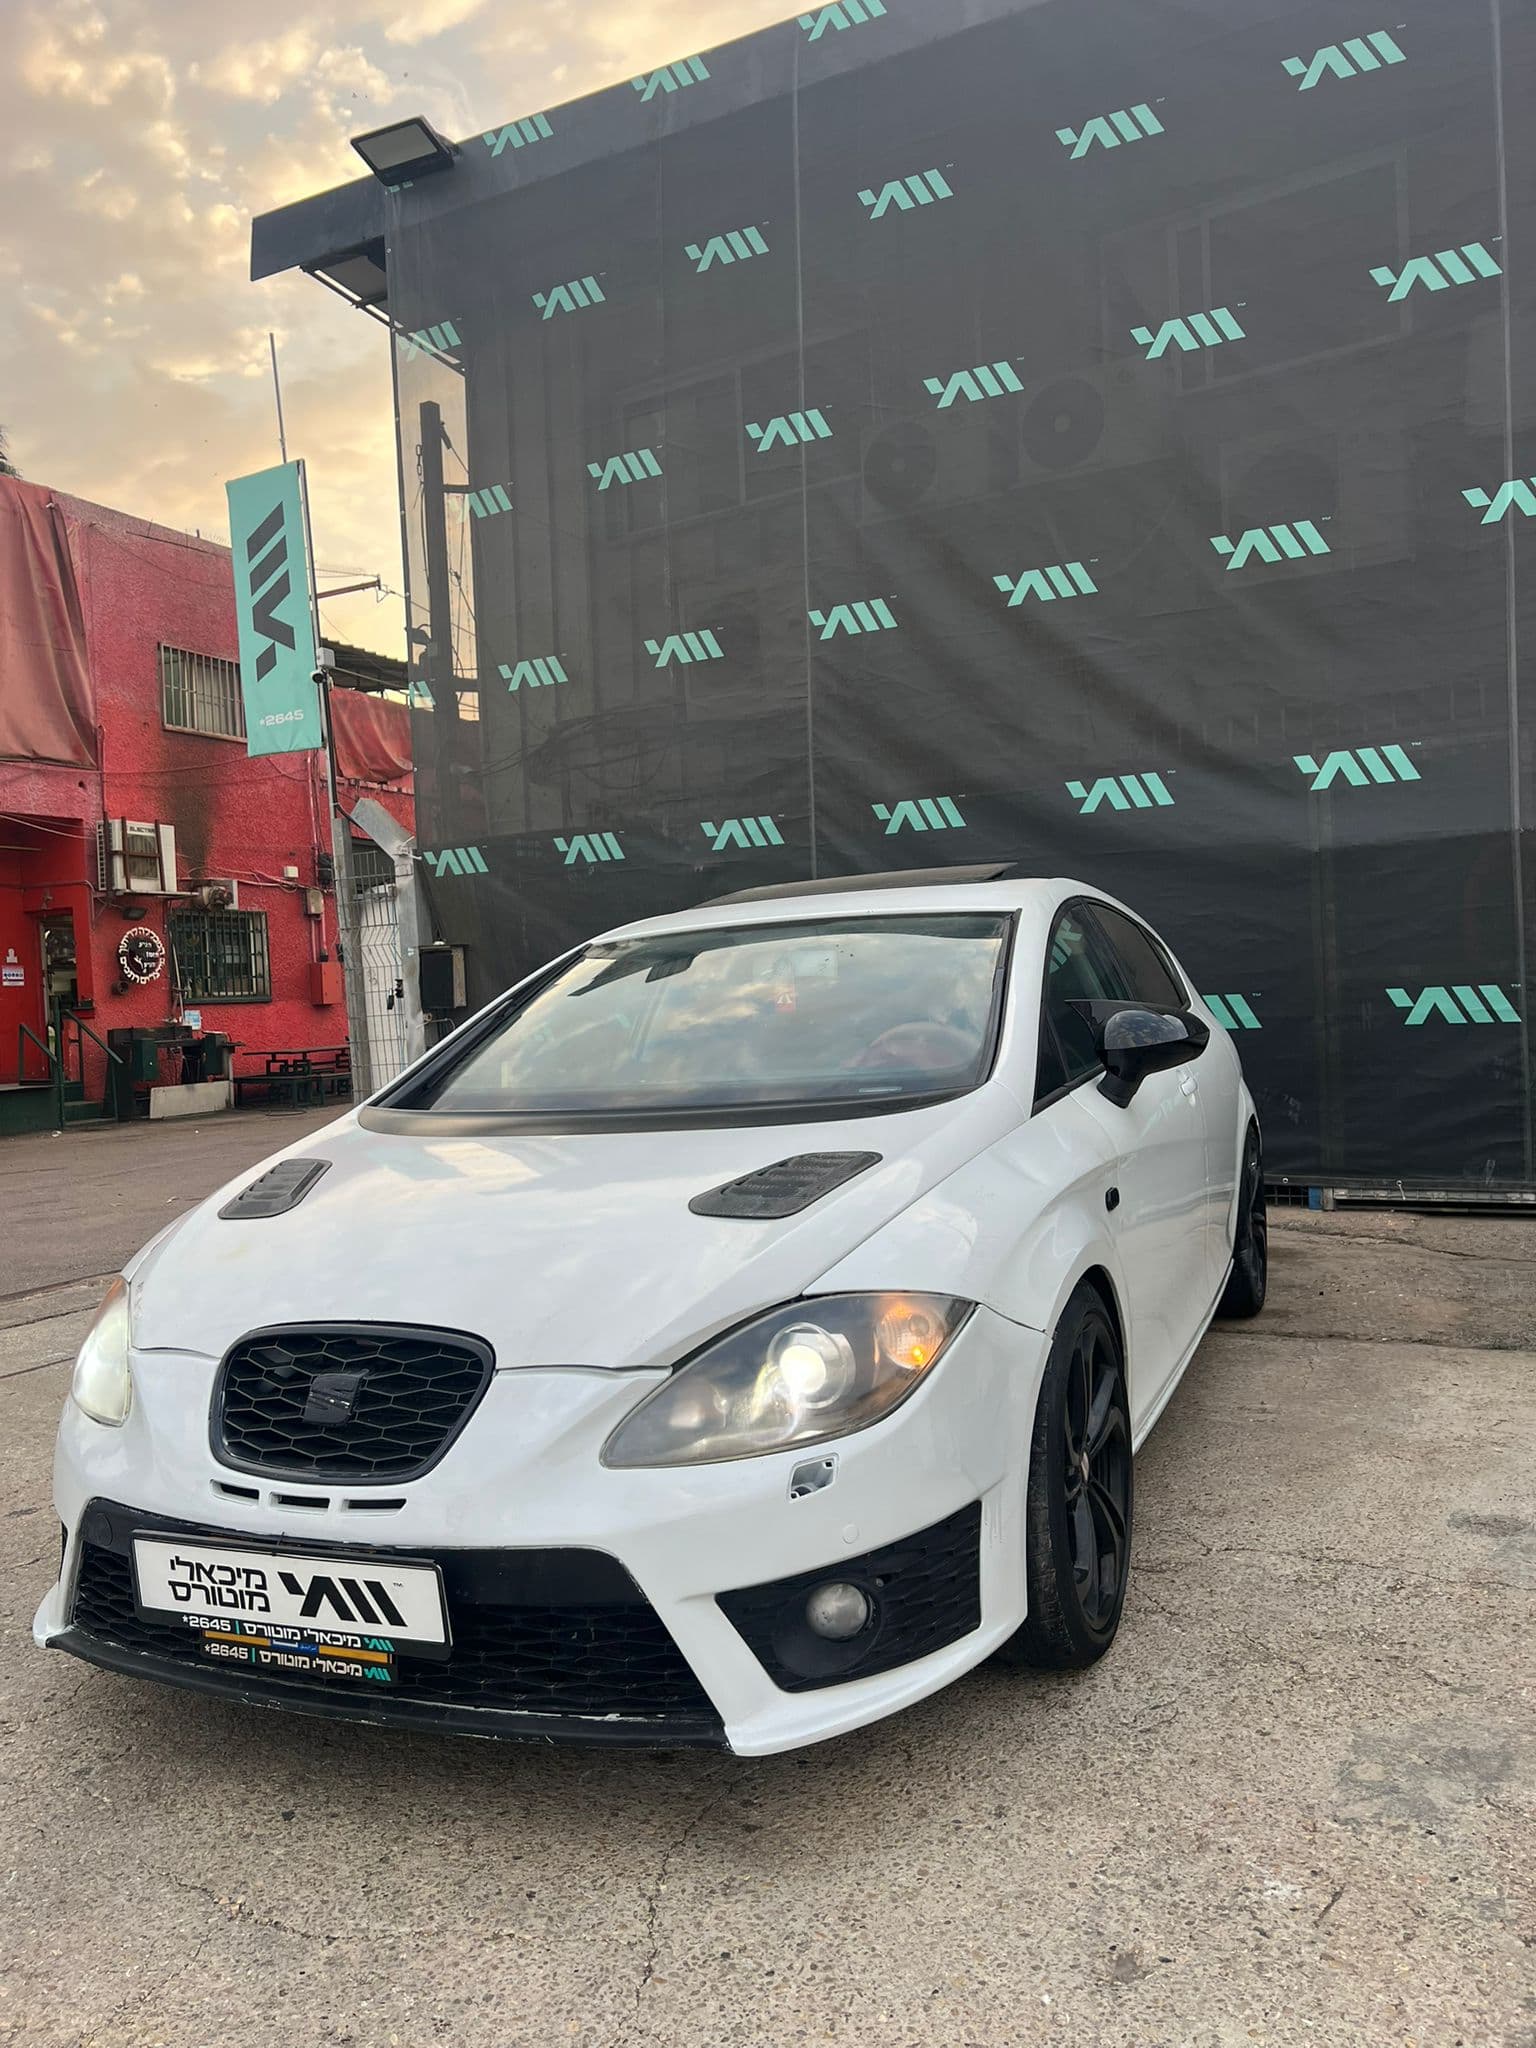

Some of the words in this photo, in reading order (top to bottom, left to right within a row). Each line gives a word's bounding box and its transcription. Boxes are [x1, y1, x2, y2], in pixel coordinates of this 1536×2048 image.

[169, 1555, 267, 1591] מיכאלי
[168, 1580, 271, 1613] מוטורס
[243, 1622, 301, 1640] מוטורס
[303, 1629, 361, 1648] מיכאלי
[259, 1649, 310, 1669] מוטורס
[312, 1657, 362, 1677] מיכאלי
